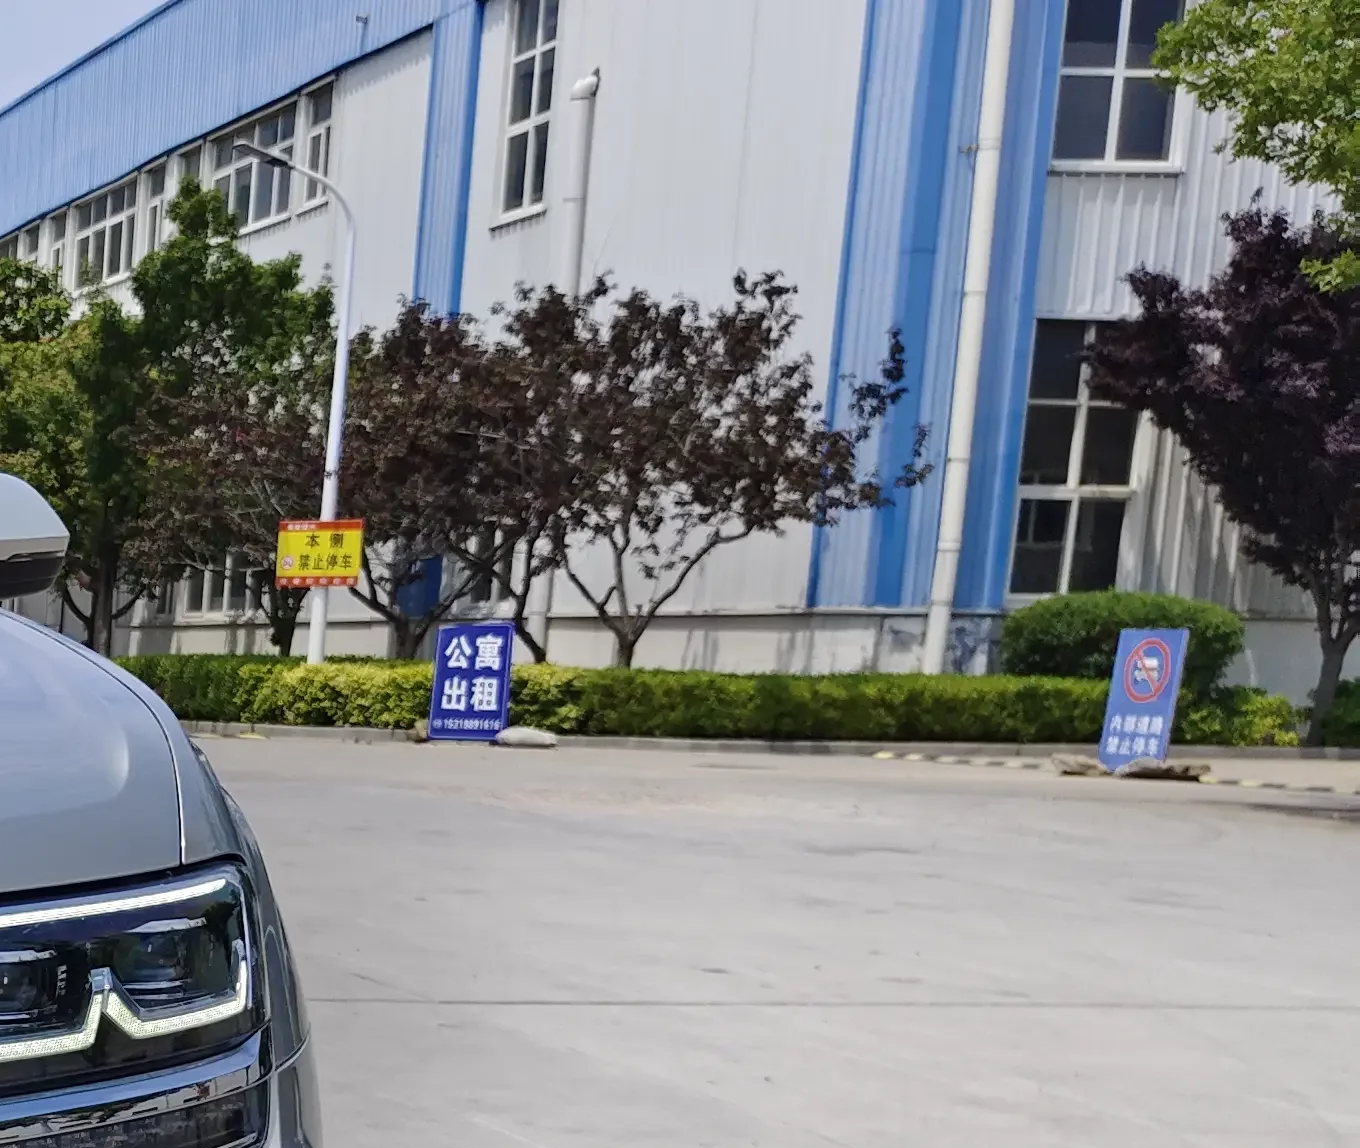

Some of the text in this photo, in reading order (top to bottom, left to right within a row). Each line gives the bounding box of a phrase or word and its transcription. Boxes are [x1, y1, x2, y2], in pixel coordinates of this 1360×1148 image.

[298, 552, 353, 571] 禁止停车
[444, 634, 505, 671] 公寓
[440, 675, 499, 712] 出租
